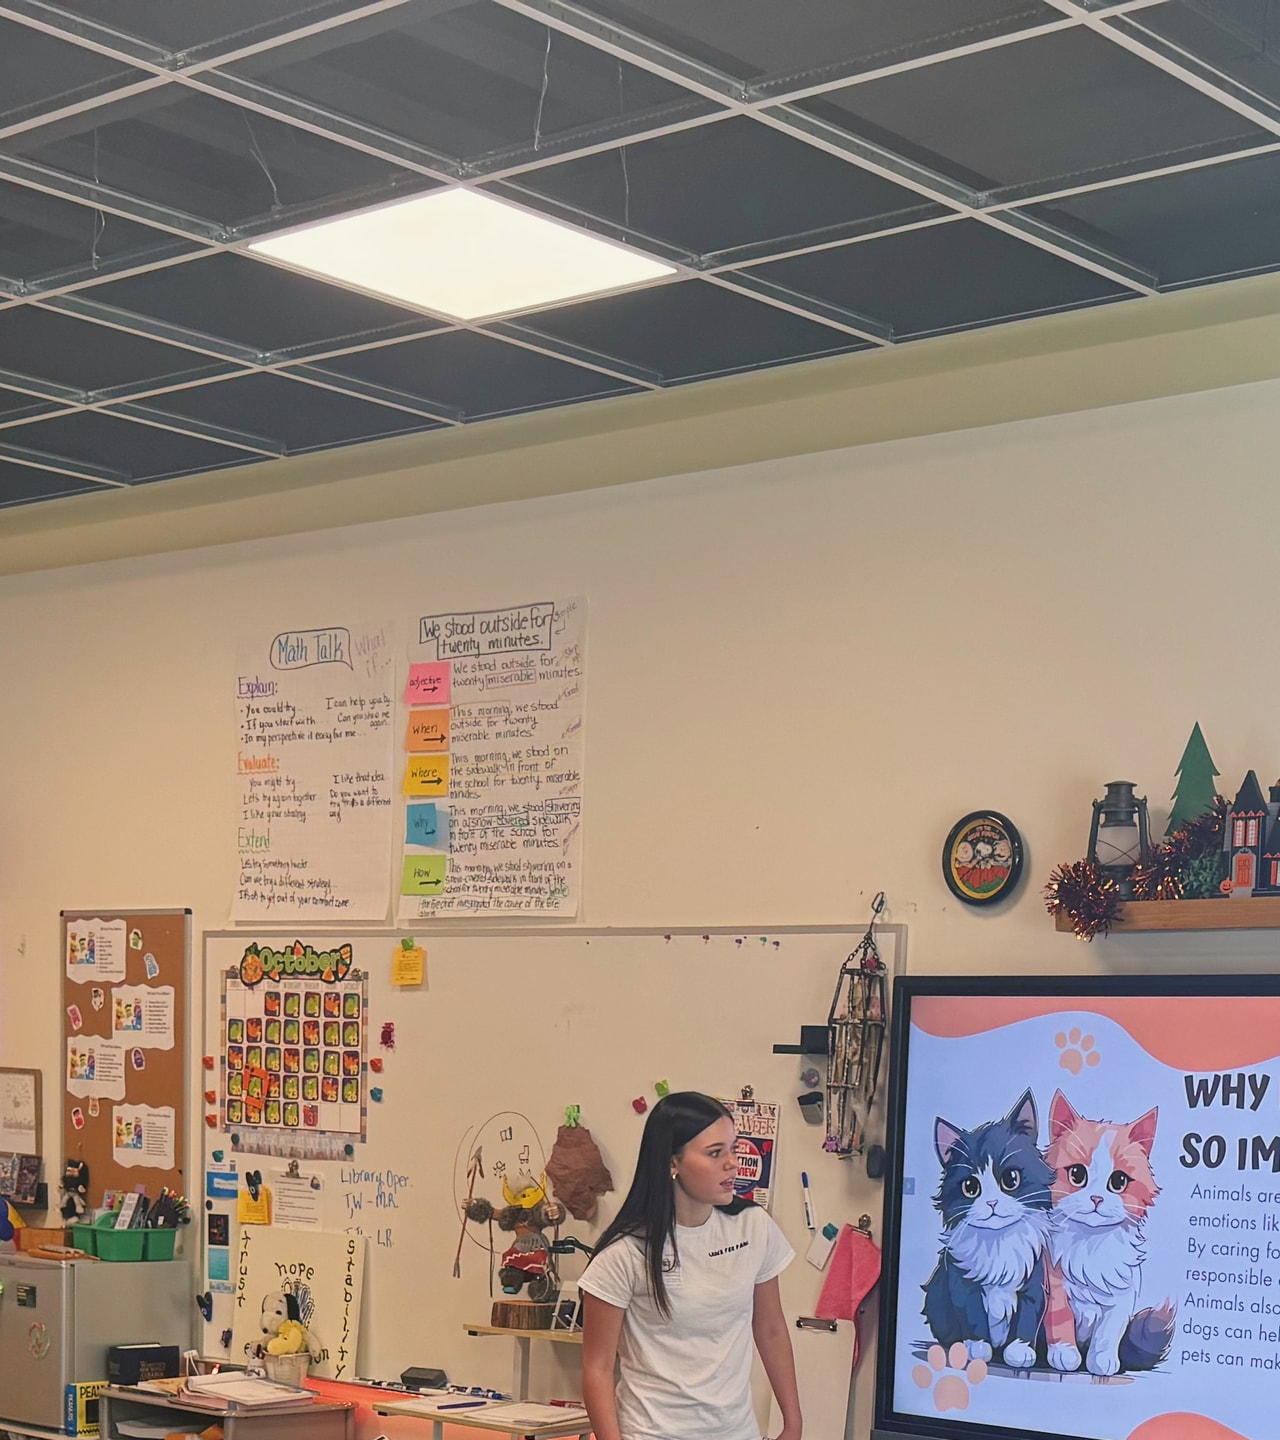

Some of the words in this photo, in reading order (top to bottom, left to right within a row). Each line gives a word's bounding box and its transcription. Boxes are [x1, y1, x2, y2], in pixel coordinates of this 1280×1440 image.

[423, 621, 441, 639] We
[444, 616, 476, 638] stood
[479, 614, 527, 635] outside
[530, 606, 548, 629] for
[278, 634, 308, 665] Math
[313, 632, 344, 662] Talk
[439, 639, 480, 659] twenty
[488, 634, 544, 650] minutes.
[471, 659, 496, 674] stood
[501, 656, 536, 672] outside
[452, 675, 485, 692] twenty
[487, 671, 534, 685] miserable
[539, 668, 583, 681] minutes.
[238, 827, 270, 848] Extend
[258, 944, 342, 975] October
[1184, 1073, 1270, 1111] WHY
[1179, 1133, 1226, 1168] SO
[341, 1168, 384, 1187] Library
[1191, 1184, 1251, 1202] Animals
[1189, 1213, 1256, 1230] emotions
[1188, 1237, 1206, 1258] By
[1211, 1242, 1259, 1263] caring
[1186, 1267, 1272, 1286] responsible
[1184, 1292, 1244, 1311] Animals
[1183, 1317, 1219, 1340] dogs
[1225, 1328, 1252, 1339] can
[1181, 1349, 1210, 1365] pets
[1217, 1354, 1243, 1366] can
